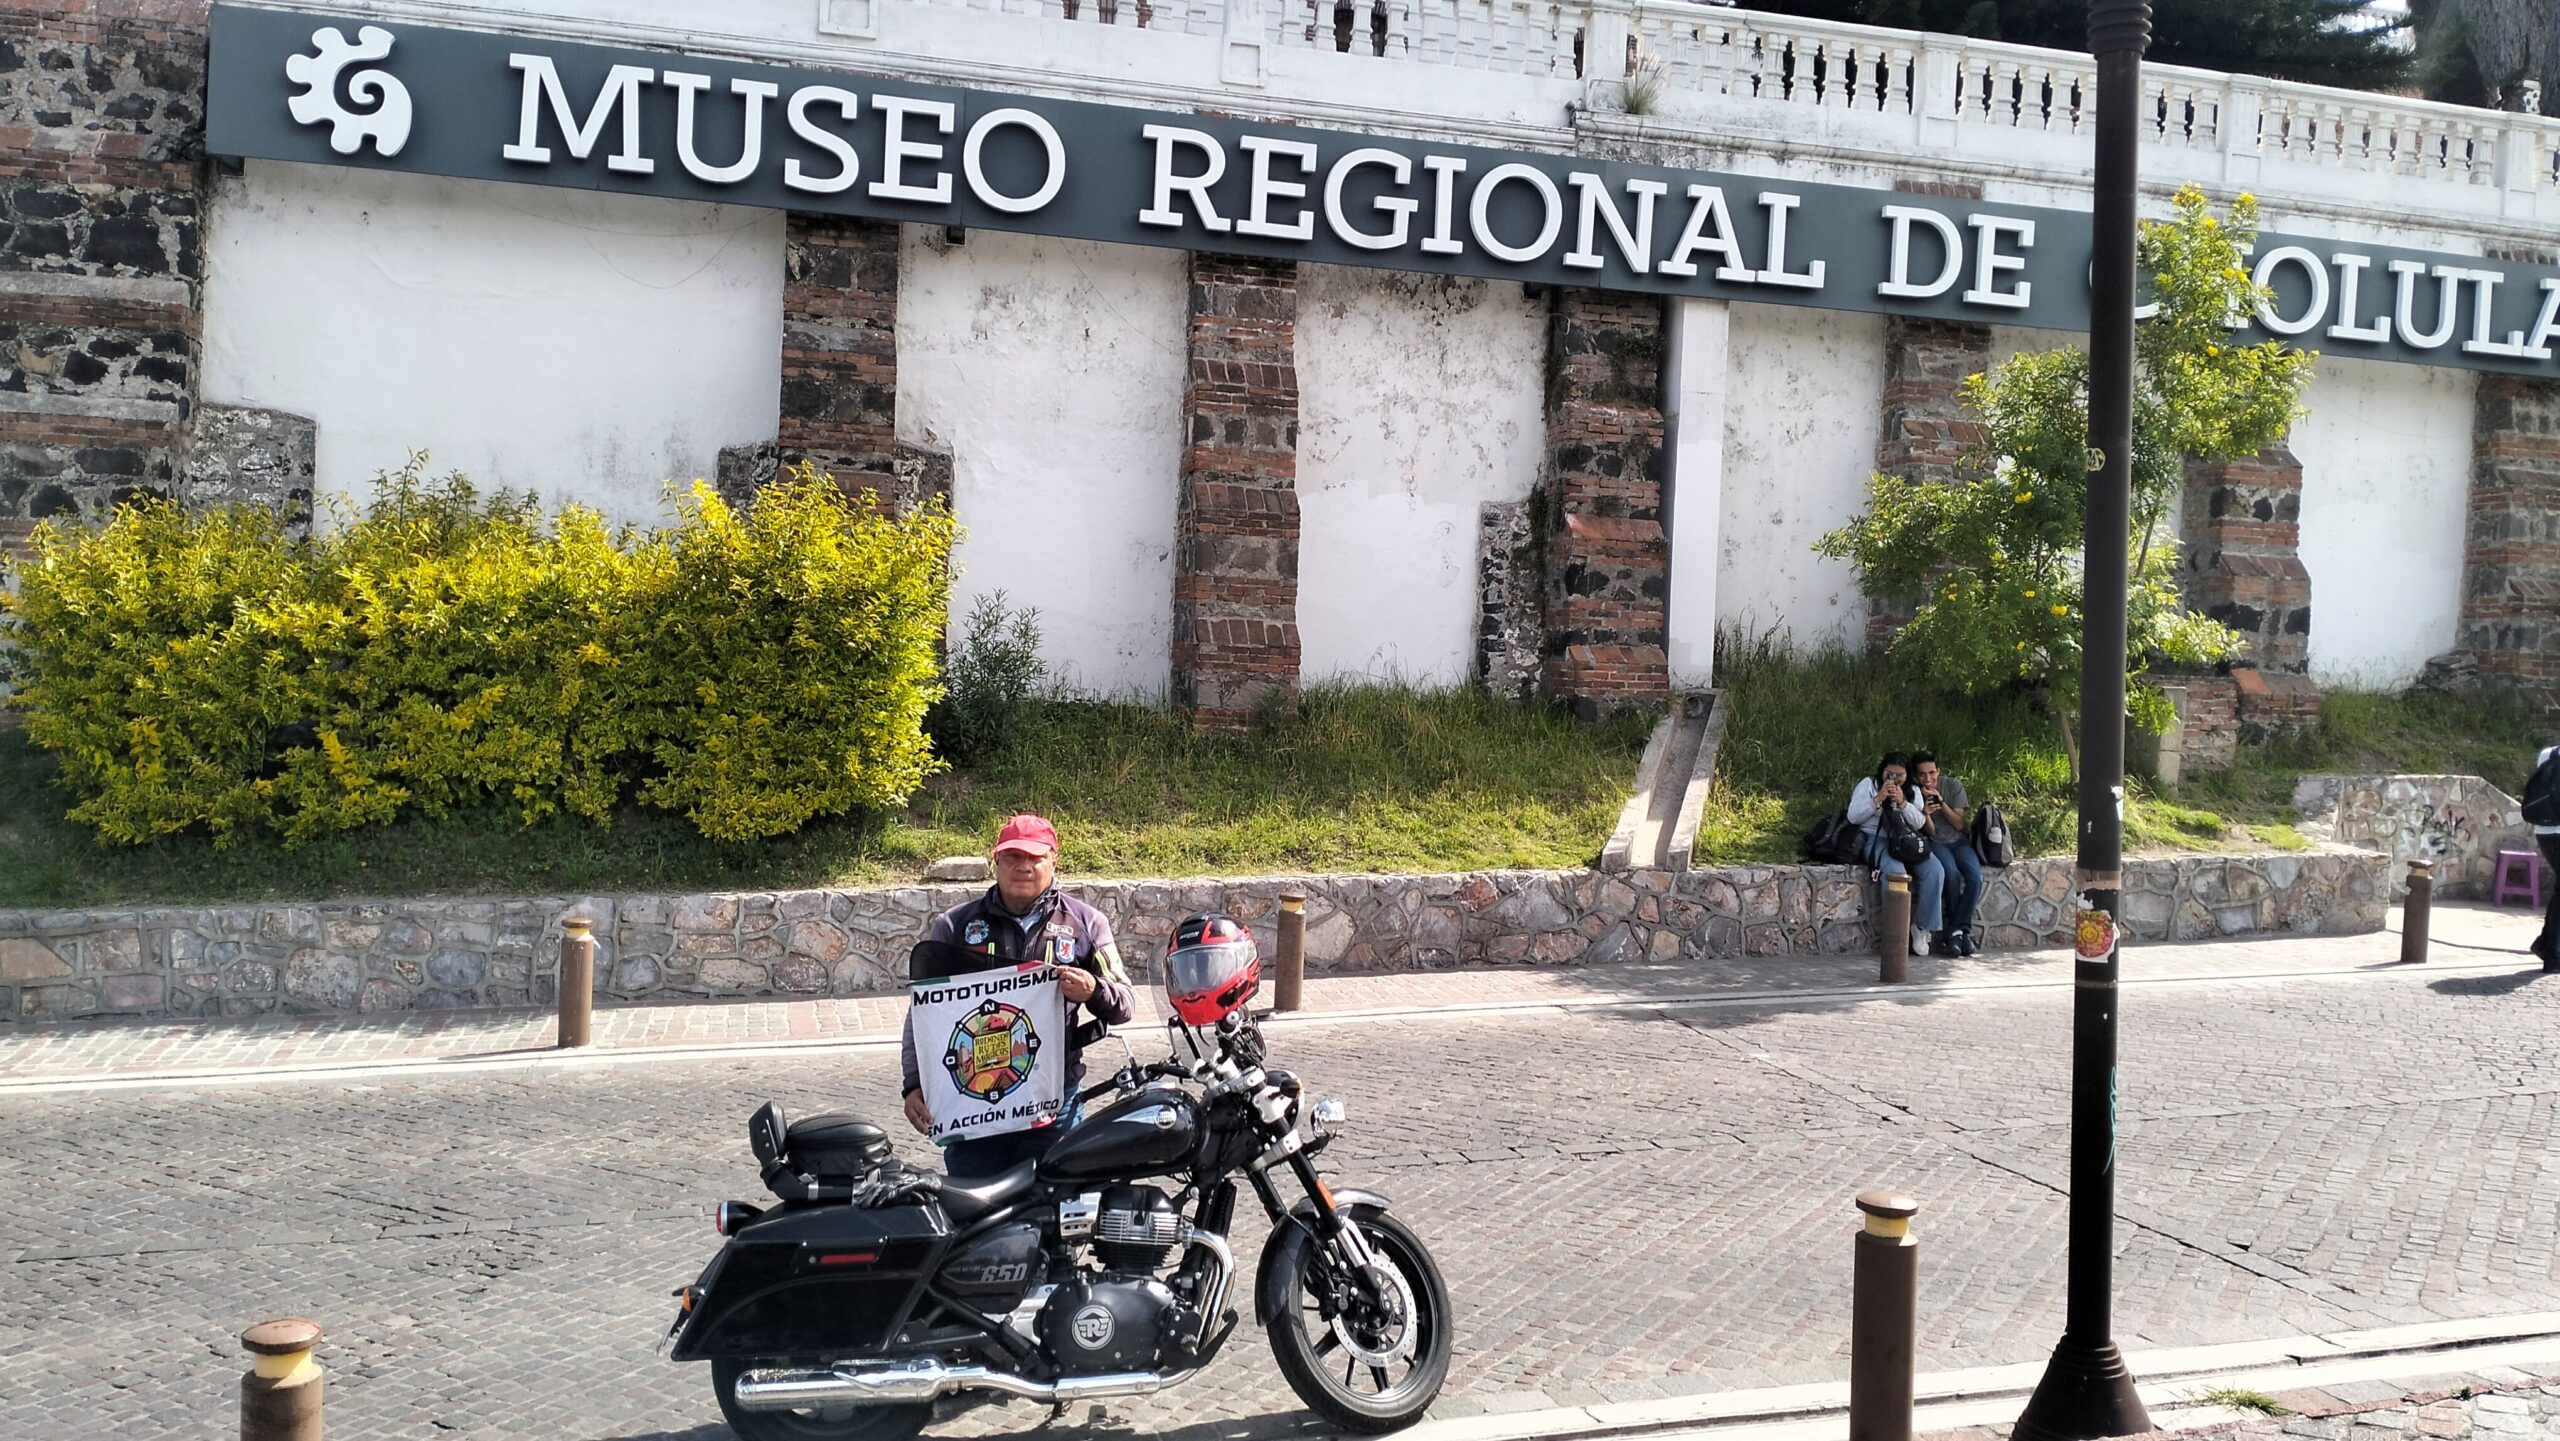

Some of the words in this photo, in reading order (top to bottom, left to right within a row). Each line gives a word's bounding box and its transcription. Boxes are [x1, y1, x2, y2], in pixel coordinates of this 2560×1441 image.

[503, 52, 1066, 213] MUSEO
[1138, 123, 1826, 289] REGIONAL
[1877, 204, 2036, 309] DE
[2089, 240, 2560, 360] OLULA
[913, 966, 1061, 1007] MOTOTURISMO
[984, 1002, 996, 1013] N
[1029, 1038, 1038, 1048] E
[945, 1055, 956, 1065] O
[989, 1090, 999, 1100] S
[949, 1107, 1006, 1132] ACCIÓN
[1012, 1098, 1060, 1117] MÉXICO
[981, 1262, 1028, 1283] 650
